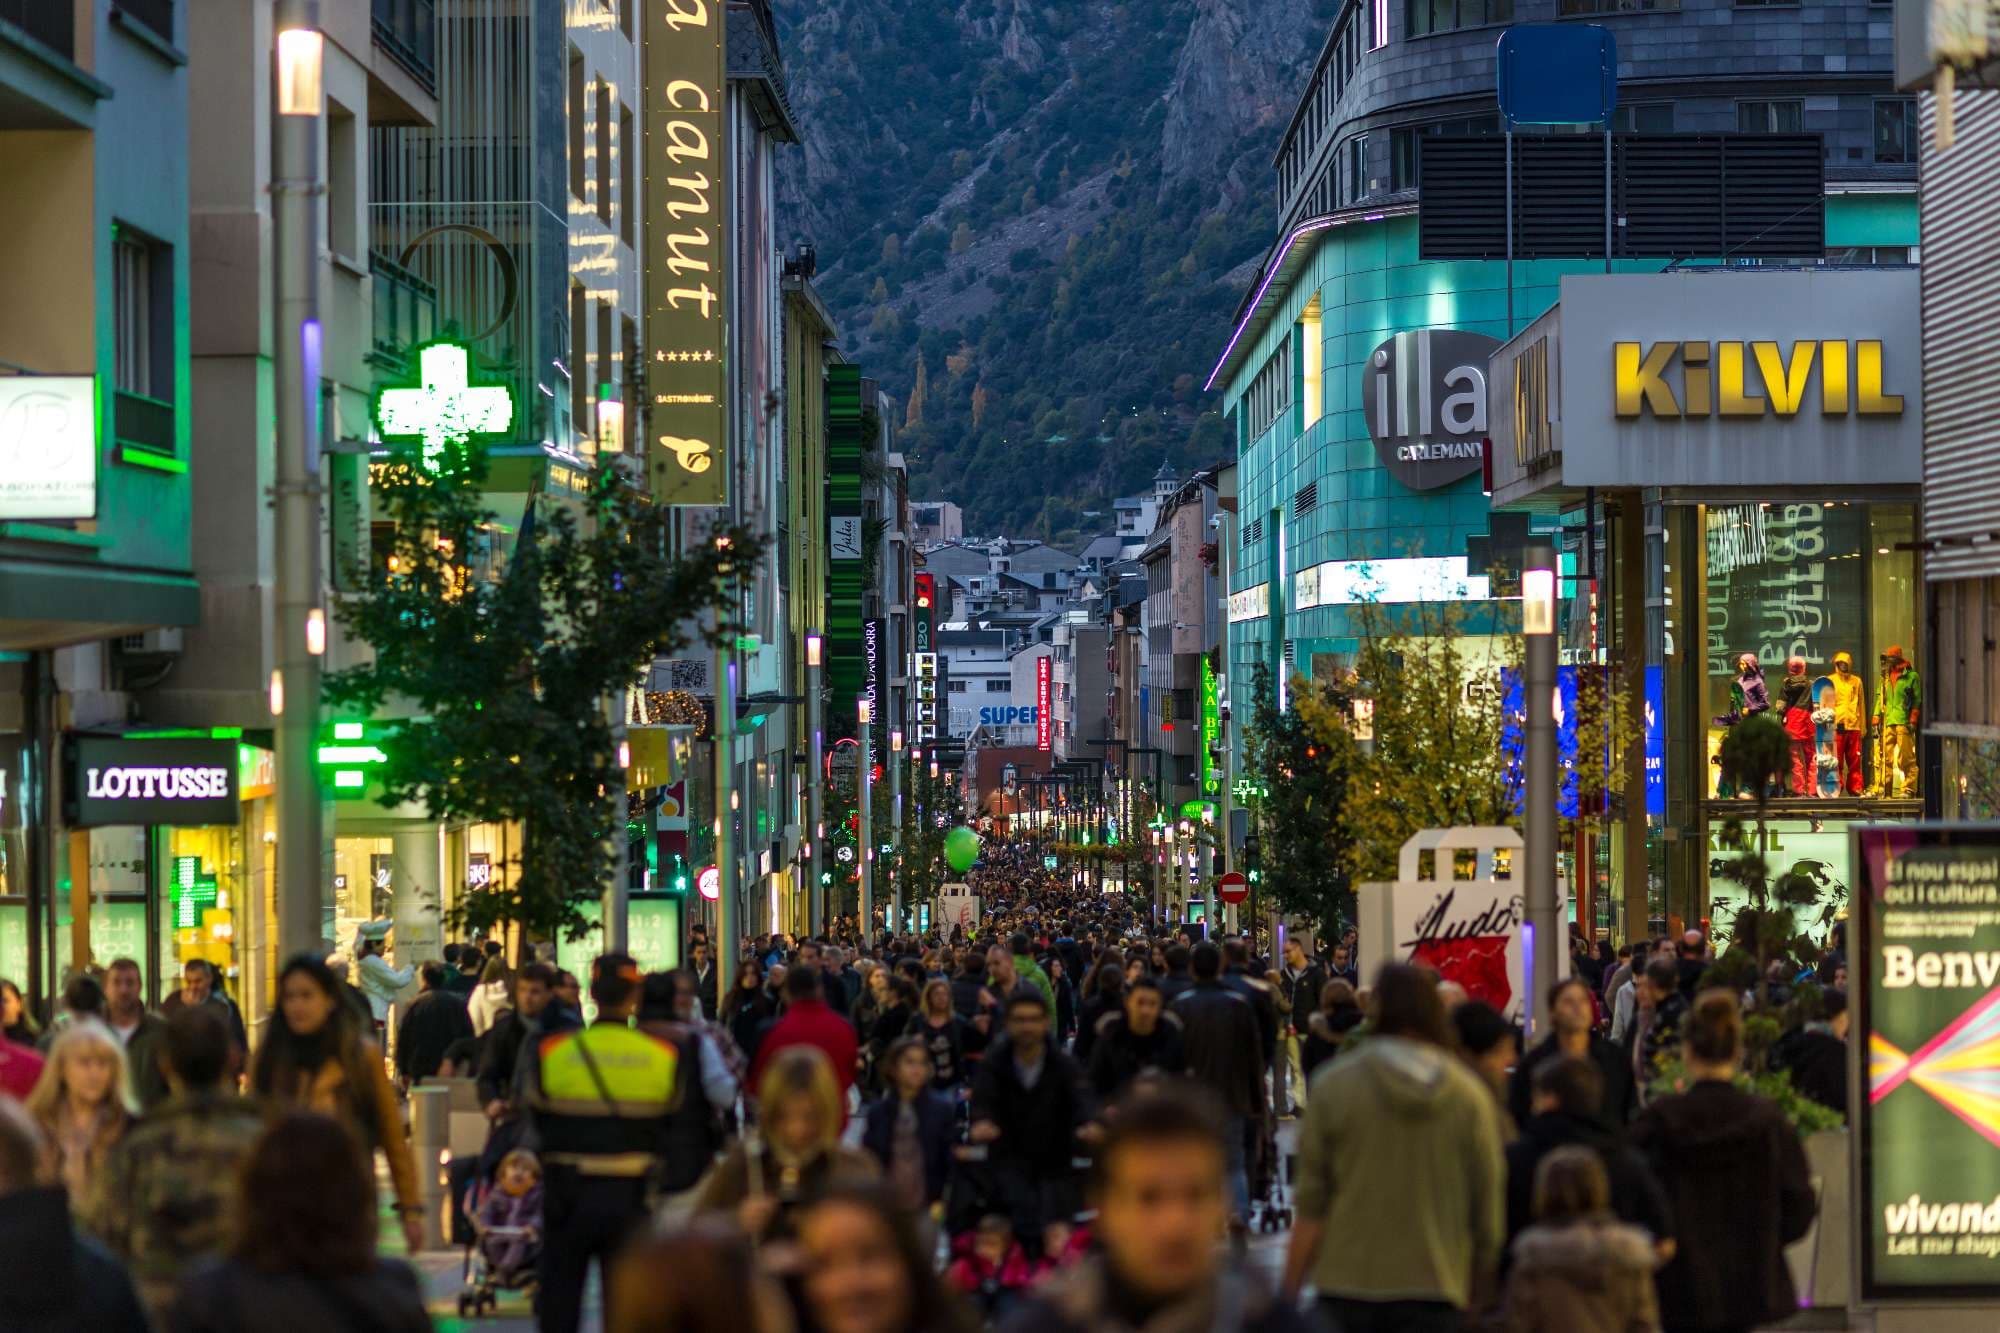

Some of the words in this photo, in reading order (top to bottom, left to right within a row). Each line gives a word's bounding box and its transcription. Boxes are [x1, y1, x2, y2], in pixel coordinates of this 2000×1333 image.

[666, 79, 717, 319] canut
[1374, 329, 1487, 438] illa
[1397, 443, 1484, 461] CARLEMANY
[87, 767, 228, 798] LOTTUSSE
[1882, 945, 2000, 988] Benv
[1885, 1193, 2000, 1234] vivand
